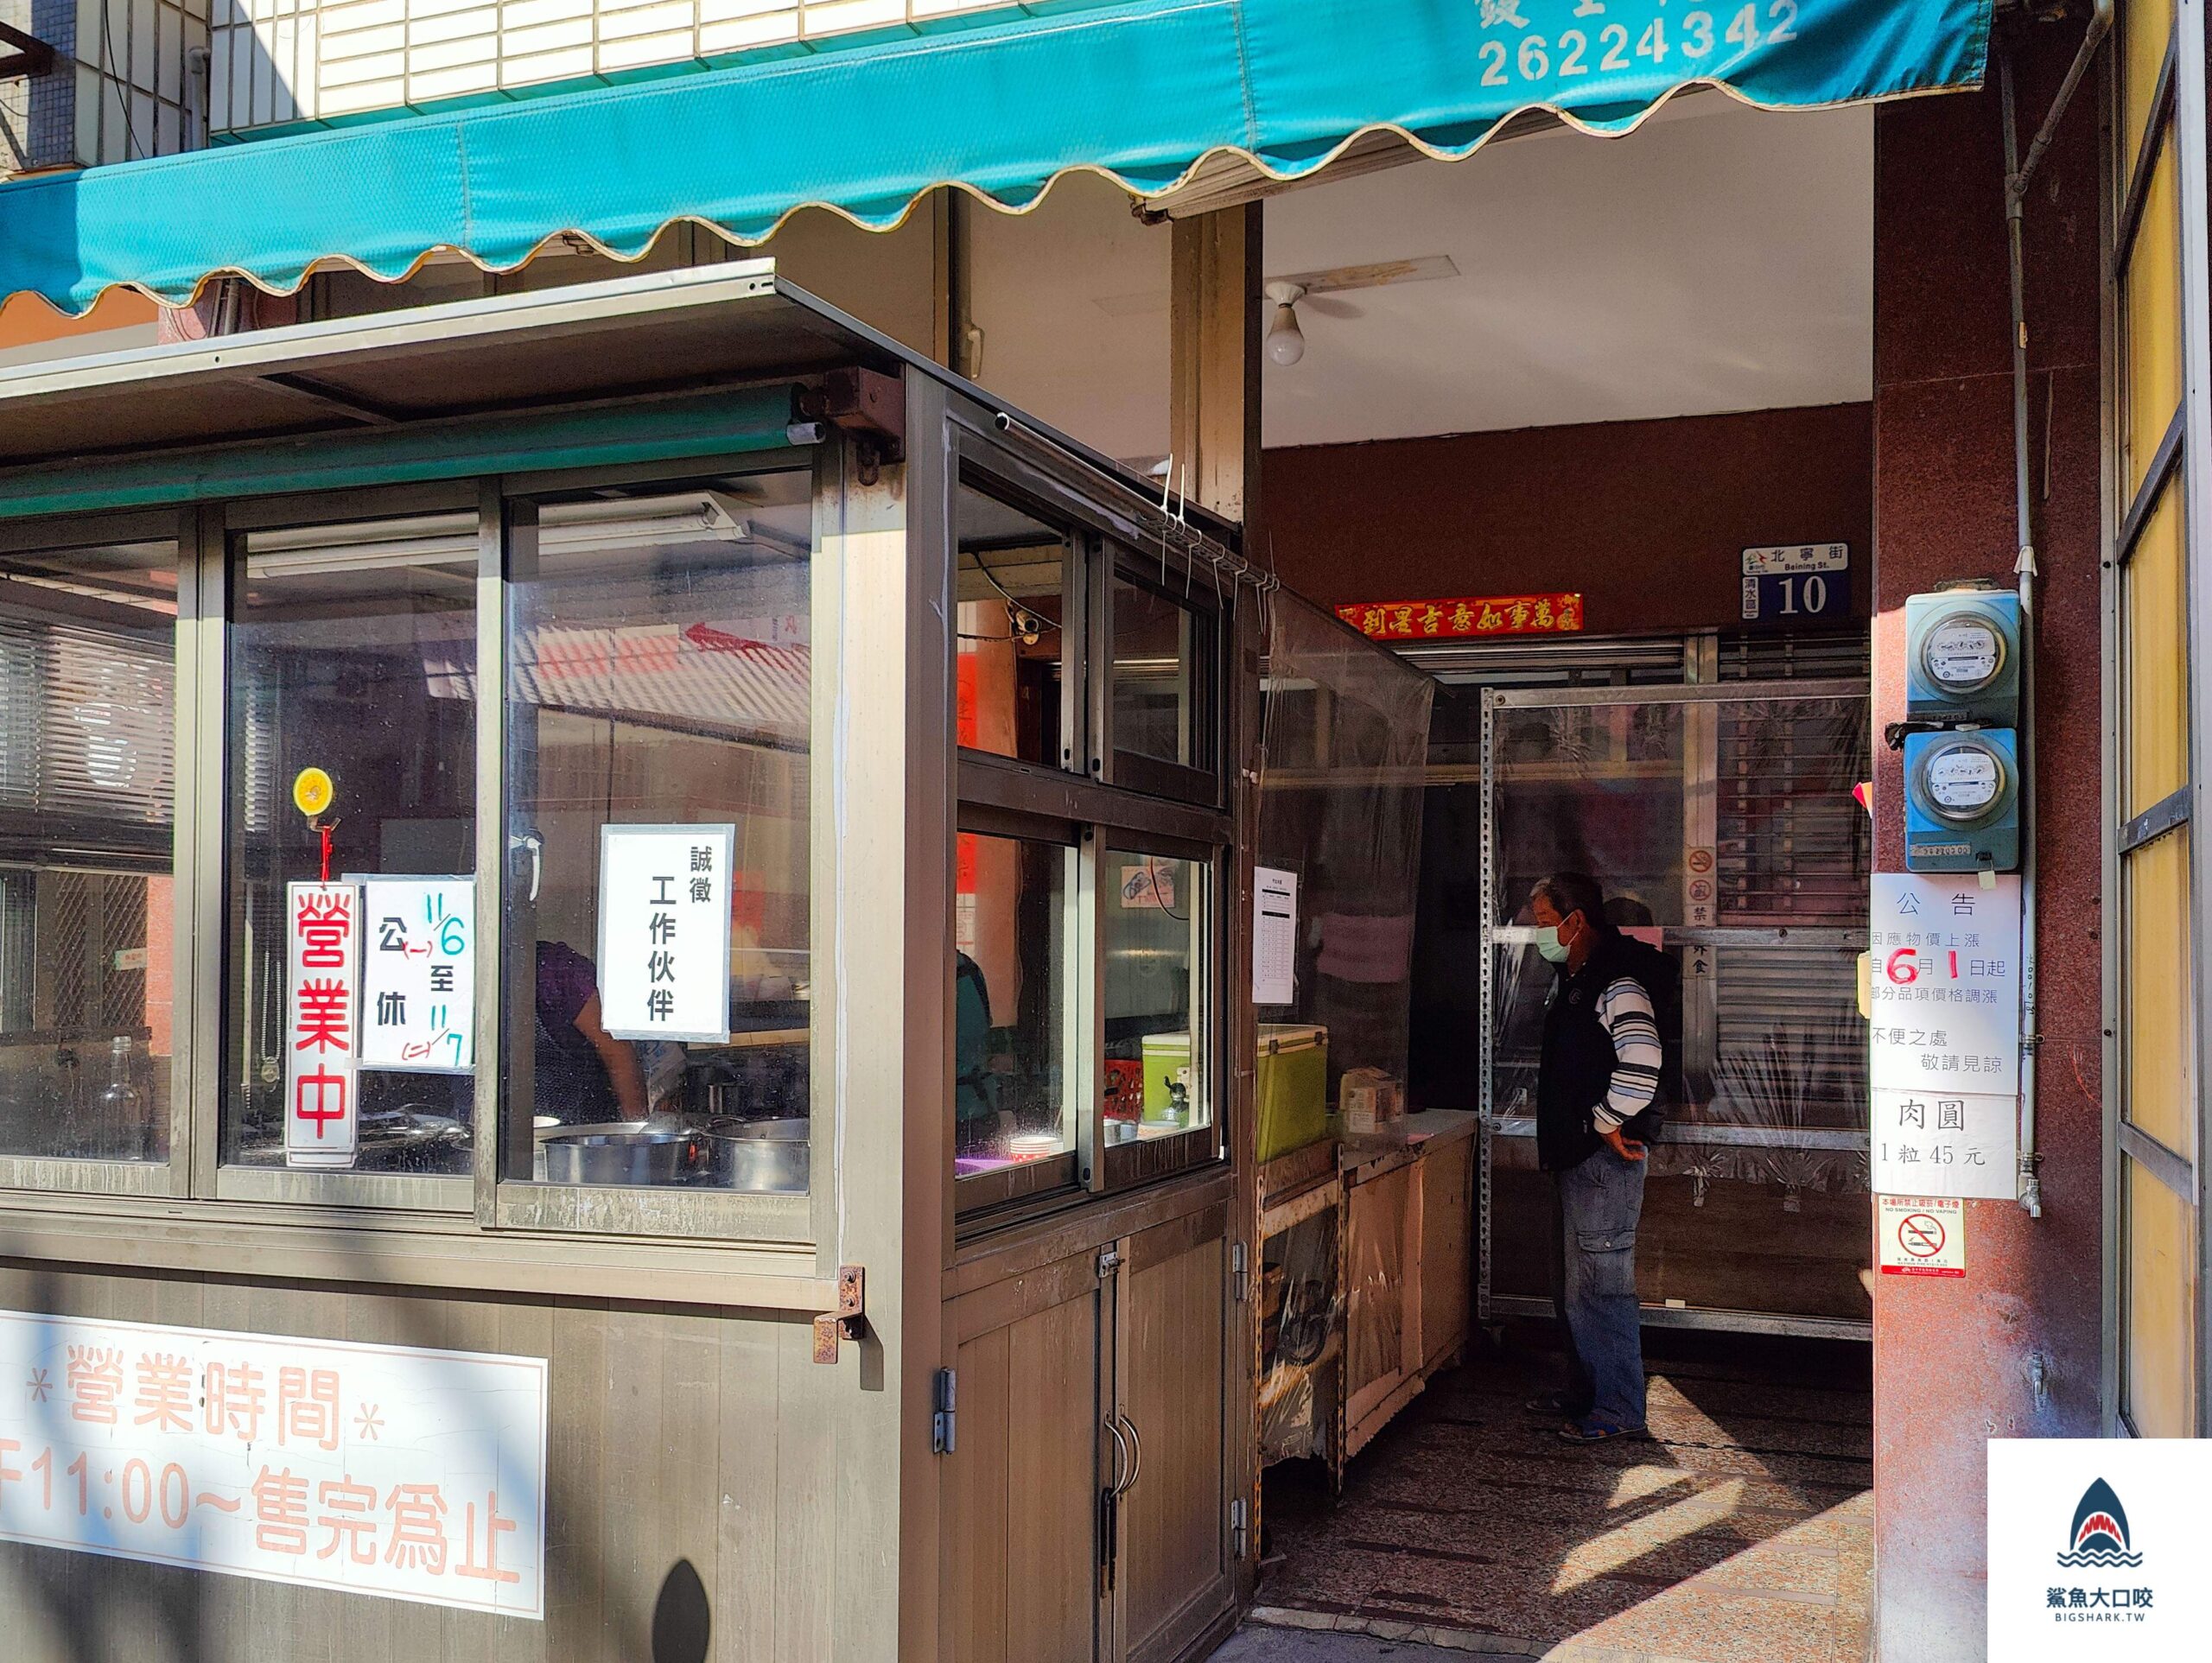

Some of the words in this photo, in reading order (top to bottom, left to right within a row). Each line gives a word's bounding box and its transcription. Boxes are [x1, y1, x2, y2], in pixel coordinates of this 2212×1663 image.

[1478, 0, 1798, 87] 26224342
[1770, 545, 1844, 562] 北寧街
[1778, 575, 1827, 614] 10
[690, 846, 713, 904] 誠徵
[1897, 892, 1976, 916] 公告
[646, 875, 677, 1022] 工作伙伴
[1693, 907, 1708, 974] 禁外食
[1872, 932, 1980, 948] 因應物價上漲
[296, 892, 350, 1139] 營業中
[1872, 1027, 1948, 1047] 不便之處
[1921, 1053, 2003, 1074] 敬請見諒
[1899, 1099, 1965, 1132] 肉圓
